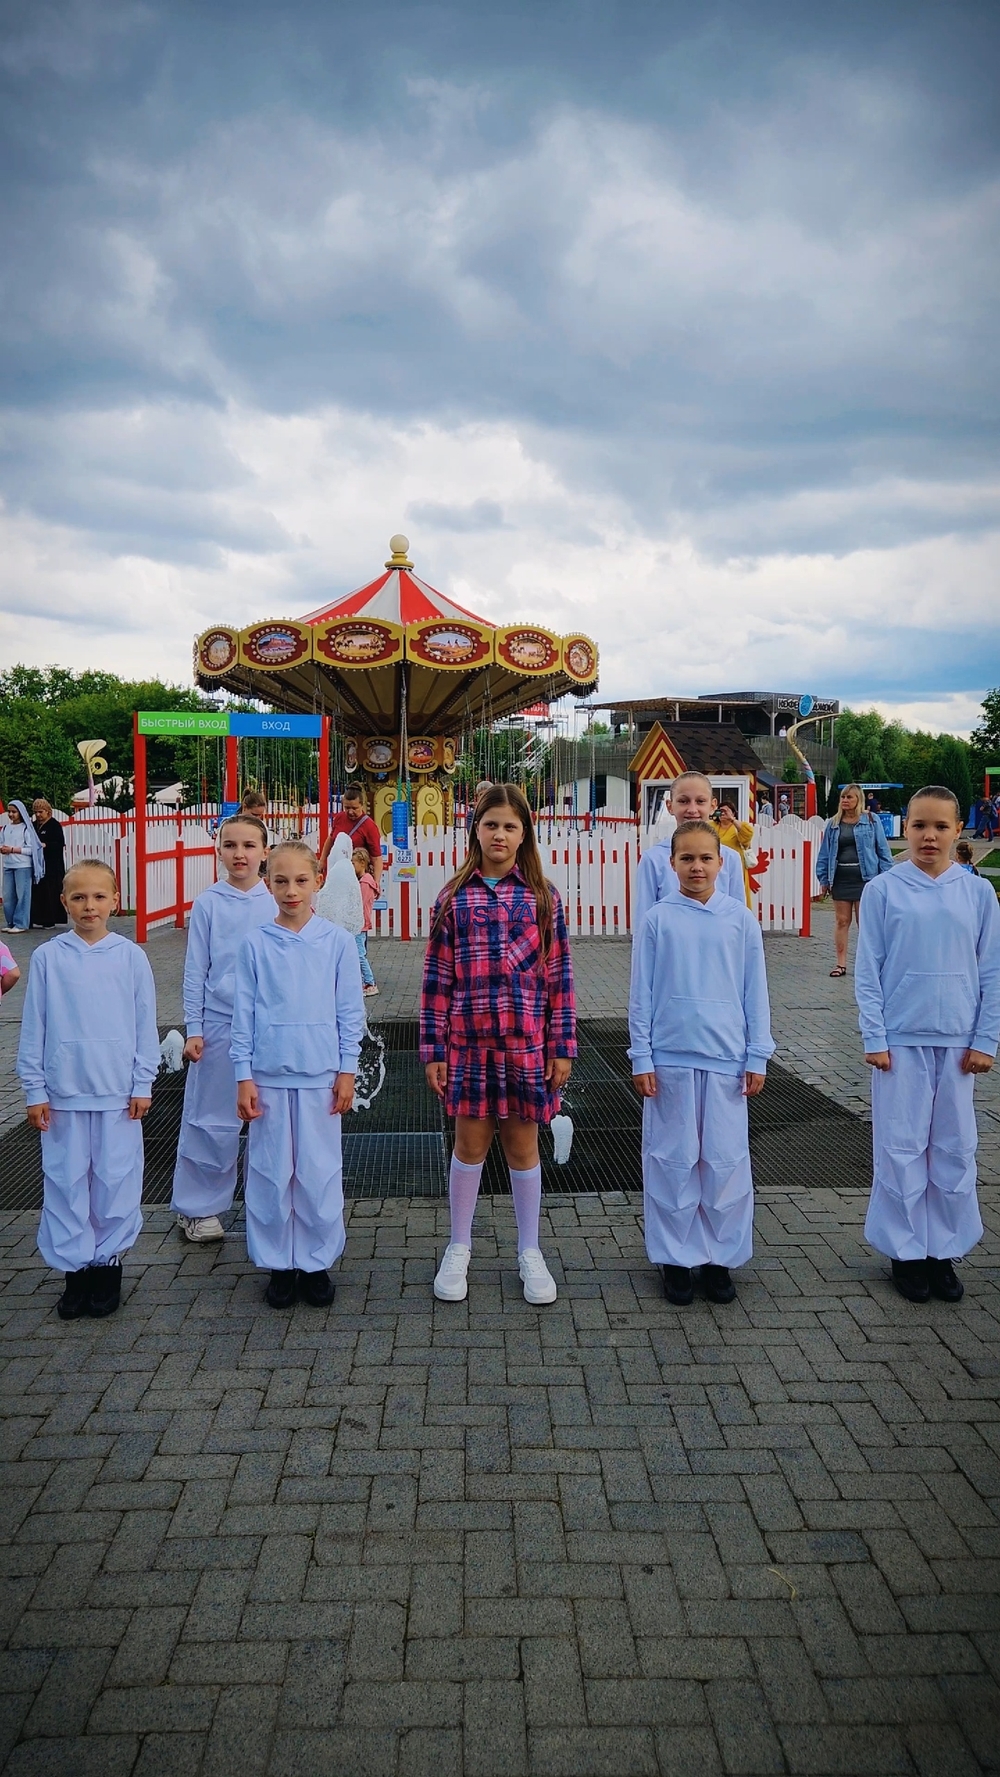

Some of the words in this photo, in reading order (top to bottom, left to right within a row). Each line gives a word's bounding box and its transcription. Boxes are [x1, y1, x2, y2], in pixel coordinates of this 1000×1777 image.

[141, 717, 196, 728] БЫСТРЫЙ
[198, 719, 228, 730] ВХОД
[261, 721, 291, 732] ВХОД
